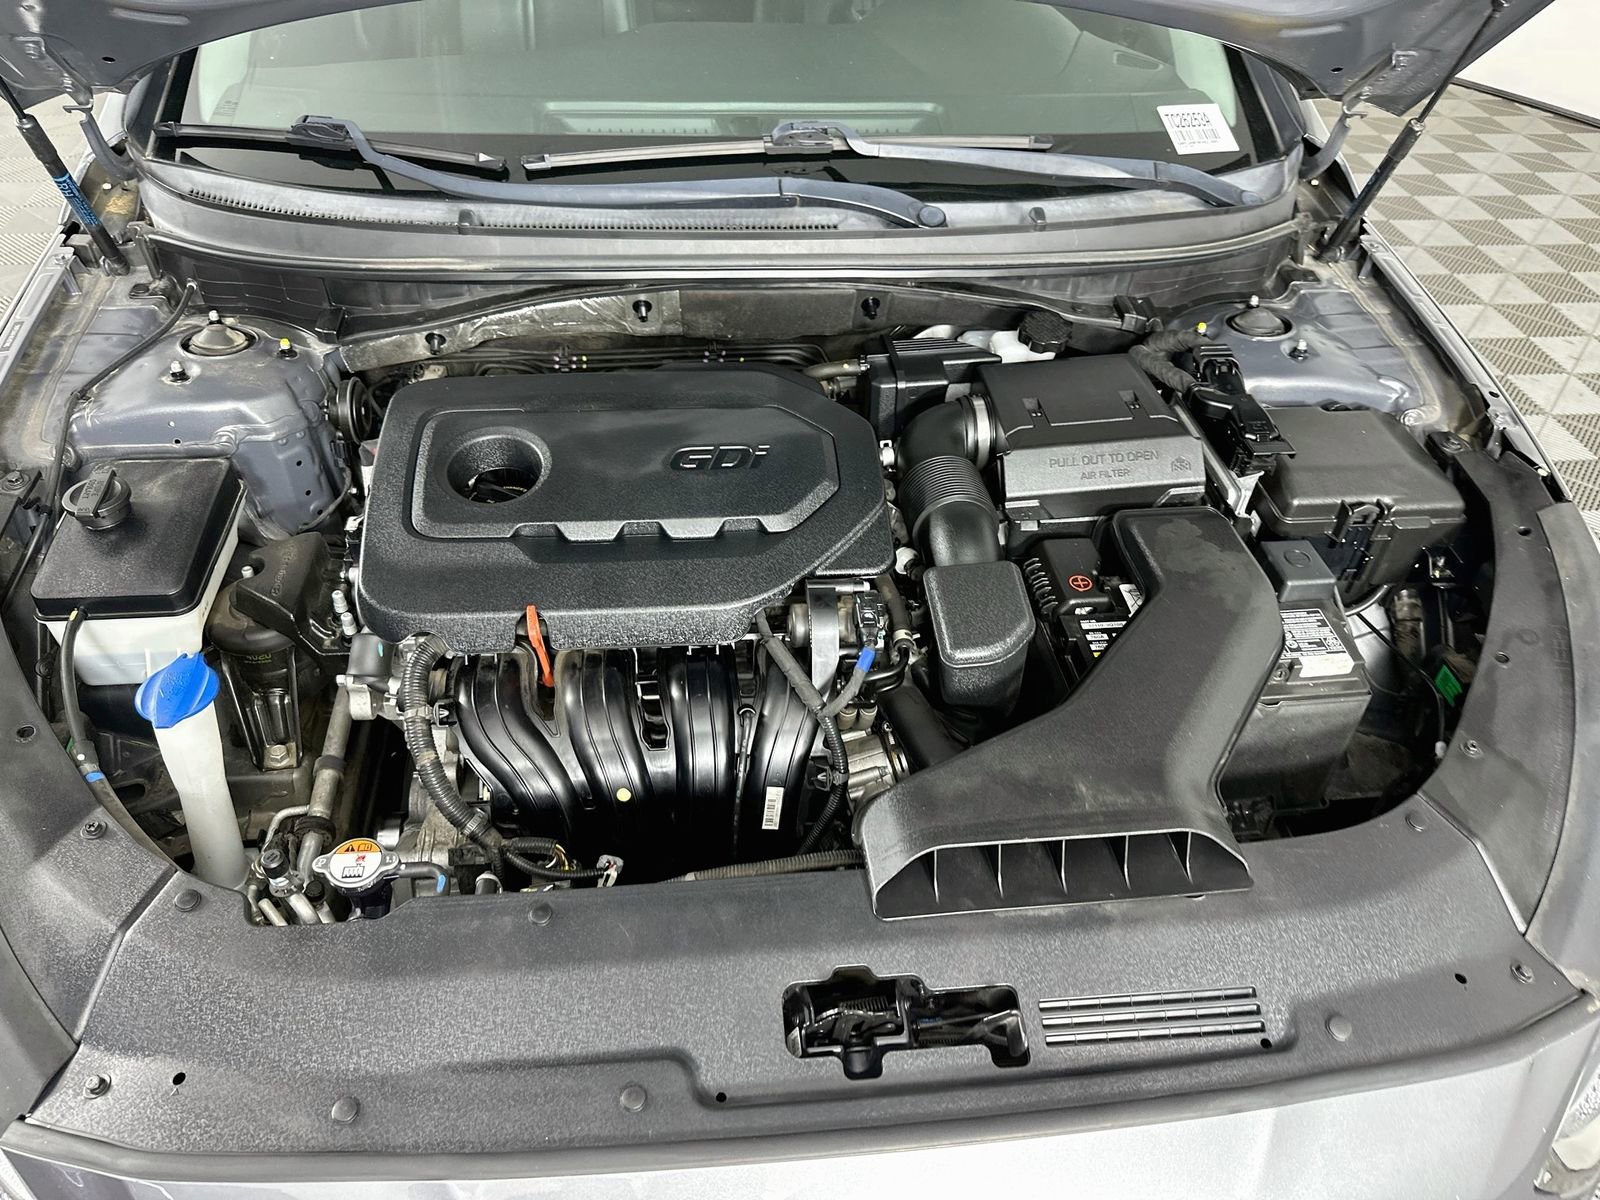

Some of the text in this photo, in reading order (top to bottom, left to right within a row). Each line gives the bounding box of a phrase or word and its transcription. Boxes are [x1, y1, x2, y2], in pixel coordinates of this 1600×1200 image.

[1164, 112, 1213, 129] TC26253A
[669, 444, 771, 470] GDi
[1049, 450, 1160, 469] PULL OUT TO OPEN
[1080, 468, 1131, 480] AIR FILTER
